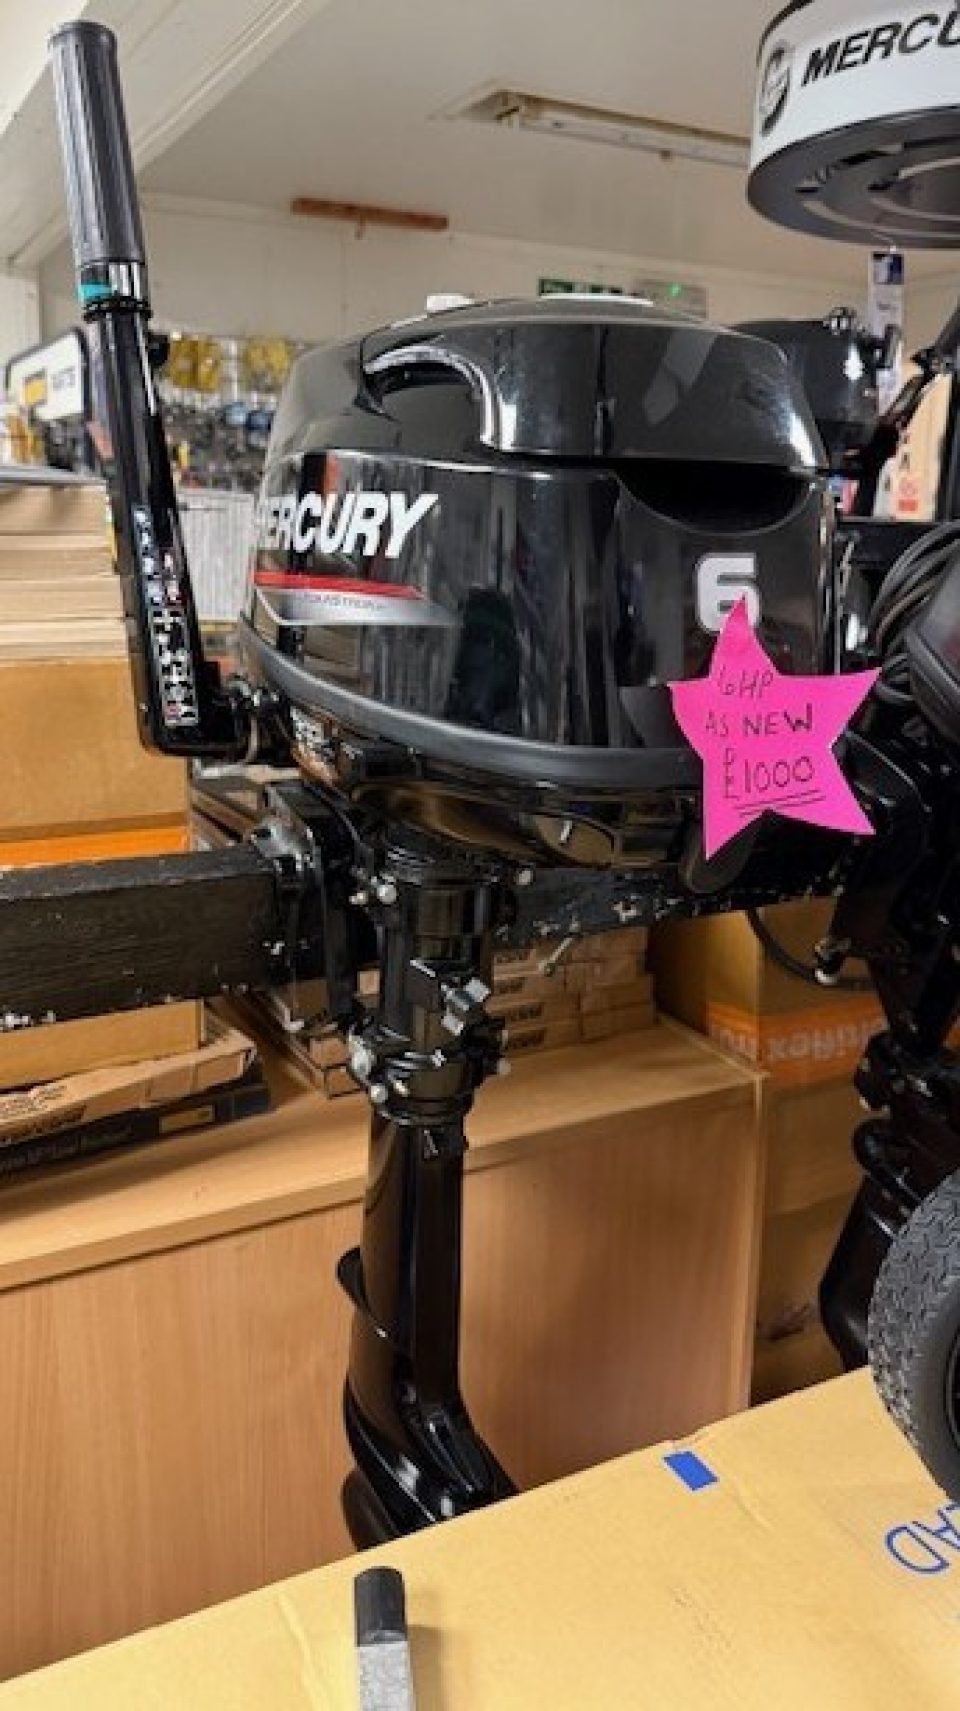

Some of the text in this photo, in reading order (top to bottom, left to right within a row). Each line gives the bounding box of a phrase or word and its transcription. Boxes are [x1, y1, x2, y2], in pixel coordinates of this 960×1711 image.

[695, 552, 761, 633] 6
[716, 665, 775, 699] 6HP
[704, 702, 814, 738] AS NEW
[722, 747, 816, 801] £1000
[885, 1503, 960, 1574] AD
